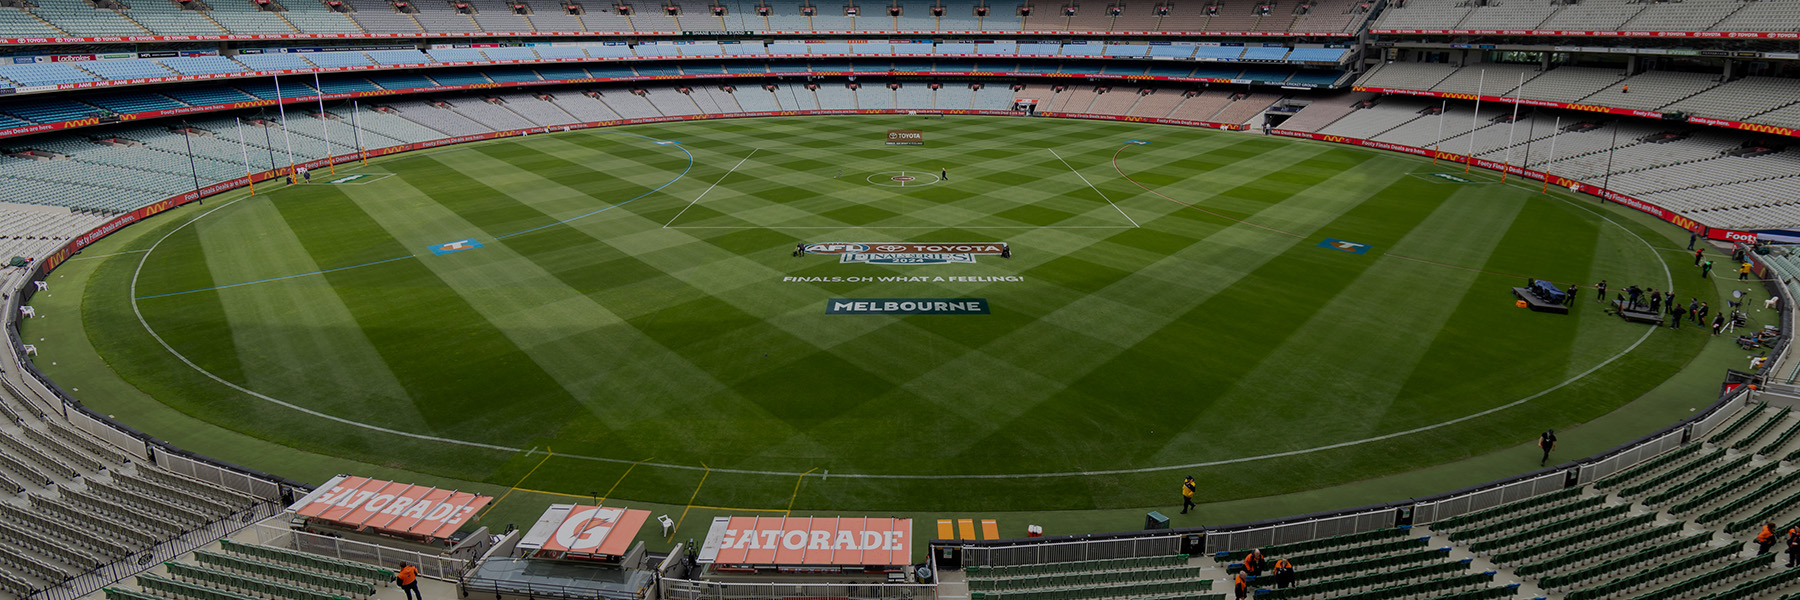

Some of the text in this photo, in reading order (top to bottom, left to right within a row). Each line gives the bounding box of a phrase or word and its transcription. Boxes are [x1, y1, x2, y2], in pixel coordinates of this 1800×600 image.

[1478, 160, 1492, 168] Footy
[1509, 166, 1522, 174] Deals
[1613, 193, 1627, 203] Finals
[1628, 198, 1641, 208] Deals
[1651, 207, 1662, 216] here.
[89, 229, 103, 240] Finals
[102, 223, 115, 233] Deals
[121, 216, 135, 225] here.
[834, 302, 981, 311] MELBOURNE
[313, 486, 474, 524] GATORADE
[556, 508, 622, 549] G
[720, 529, 903, 550] GATORADE
